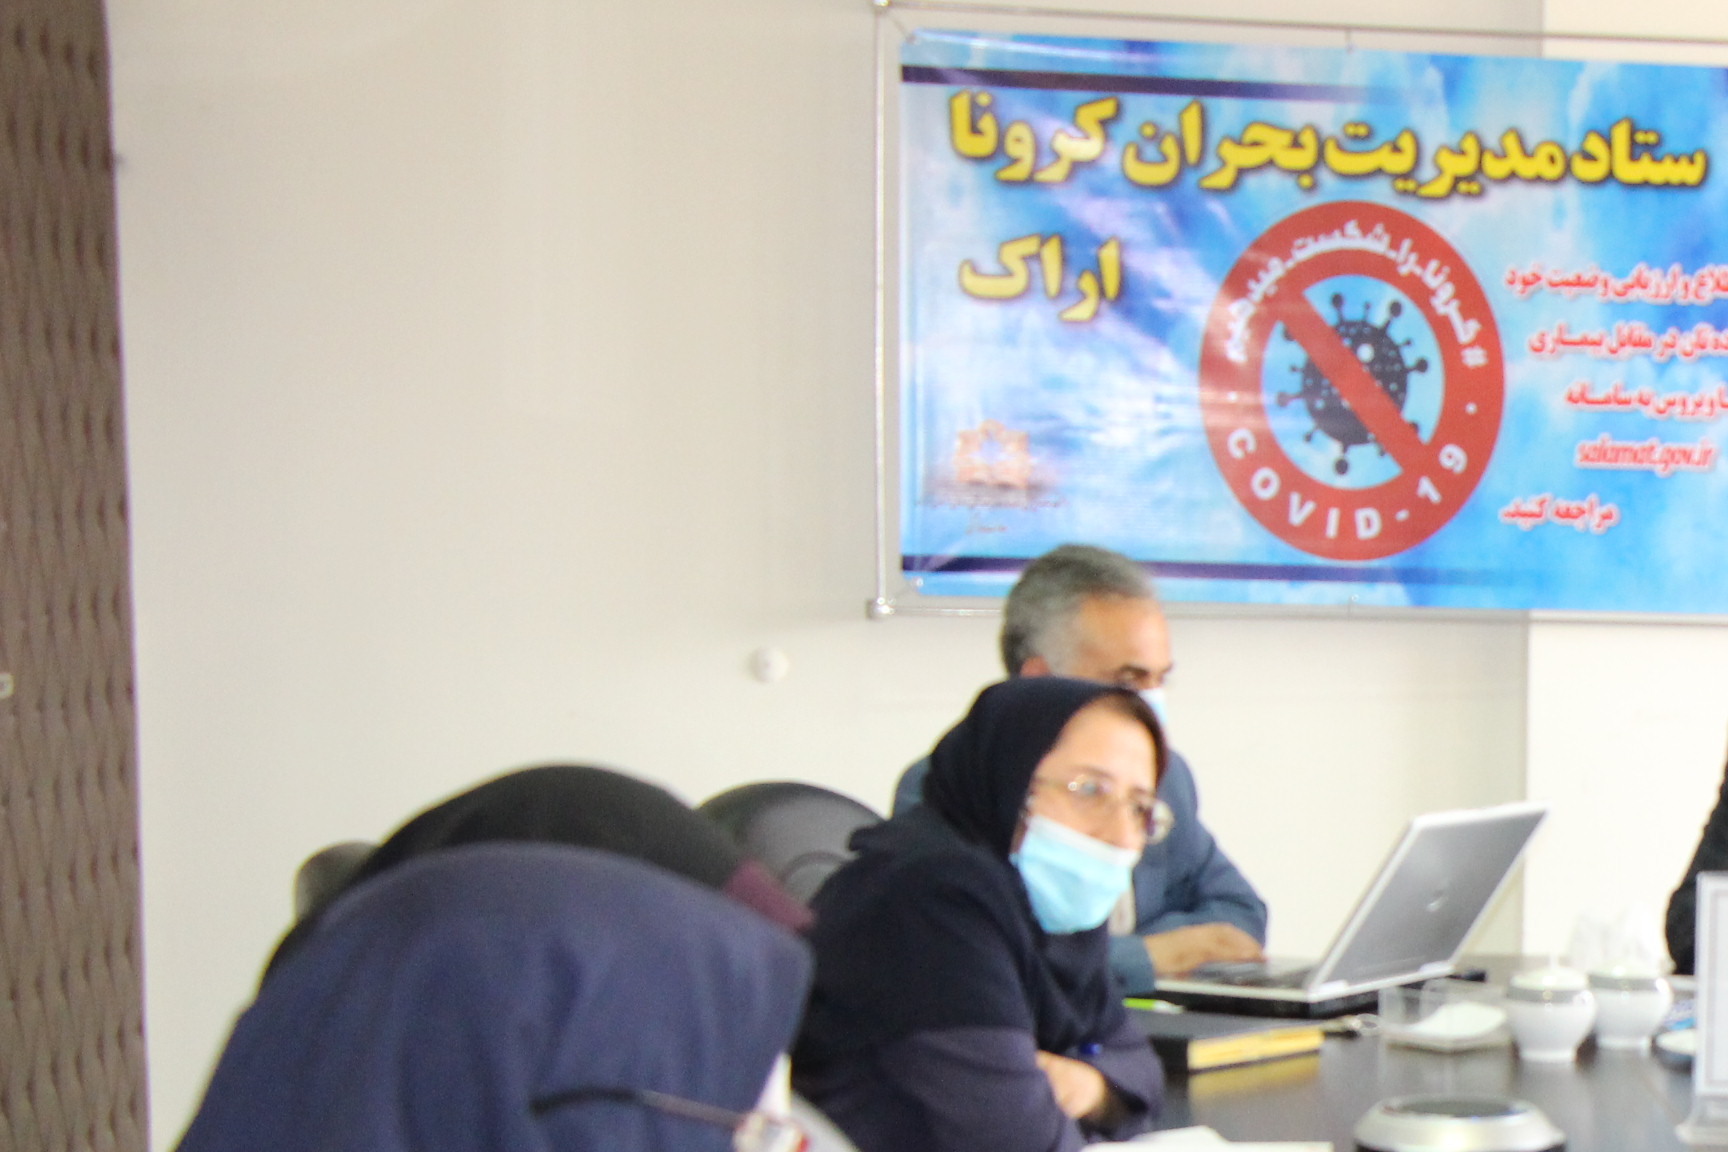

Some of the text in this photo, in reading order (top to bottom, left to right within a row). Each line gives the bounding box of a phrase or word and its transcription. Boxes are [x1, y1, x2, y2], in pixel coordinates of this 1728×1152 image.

[949, 88, 1707, 199] ستاد مدیریت بحران کرونا
[957, 233, 1122, 323] اراک
[1226, 427, 1470, 541] COVID-19
